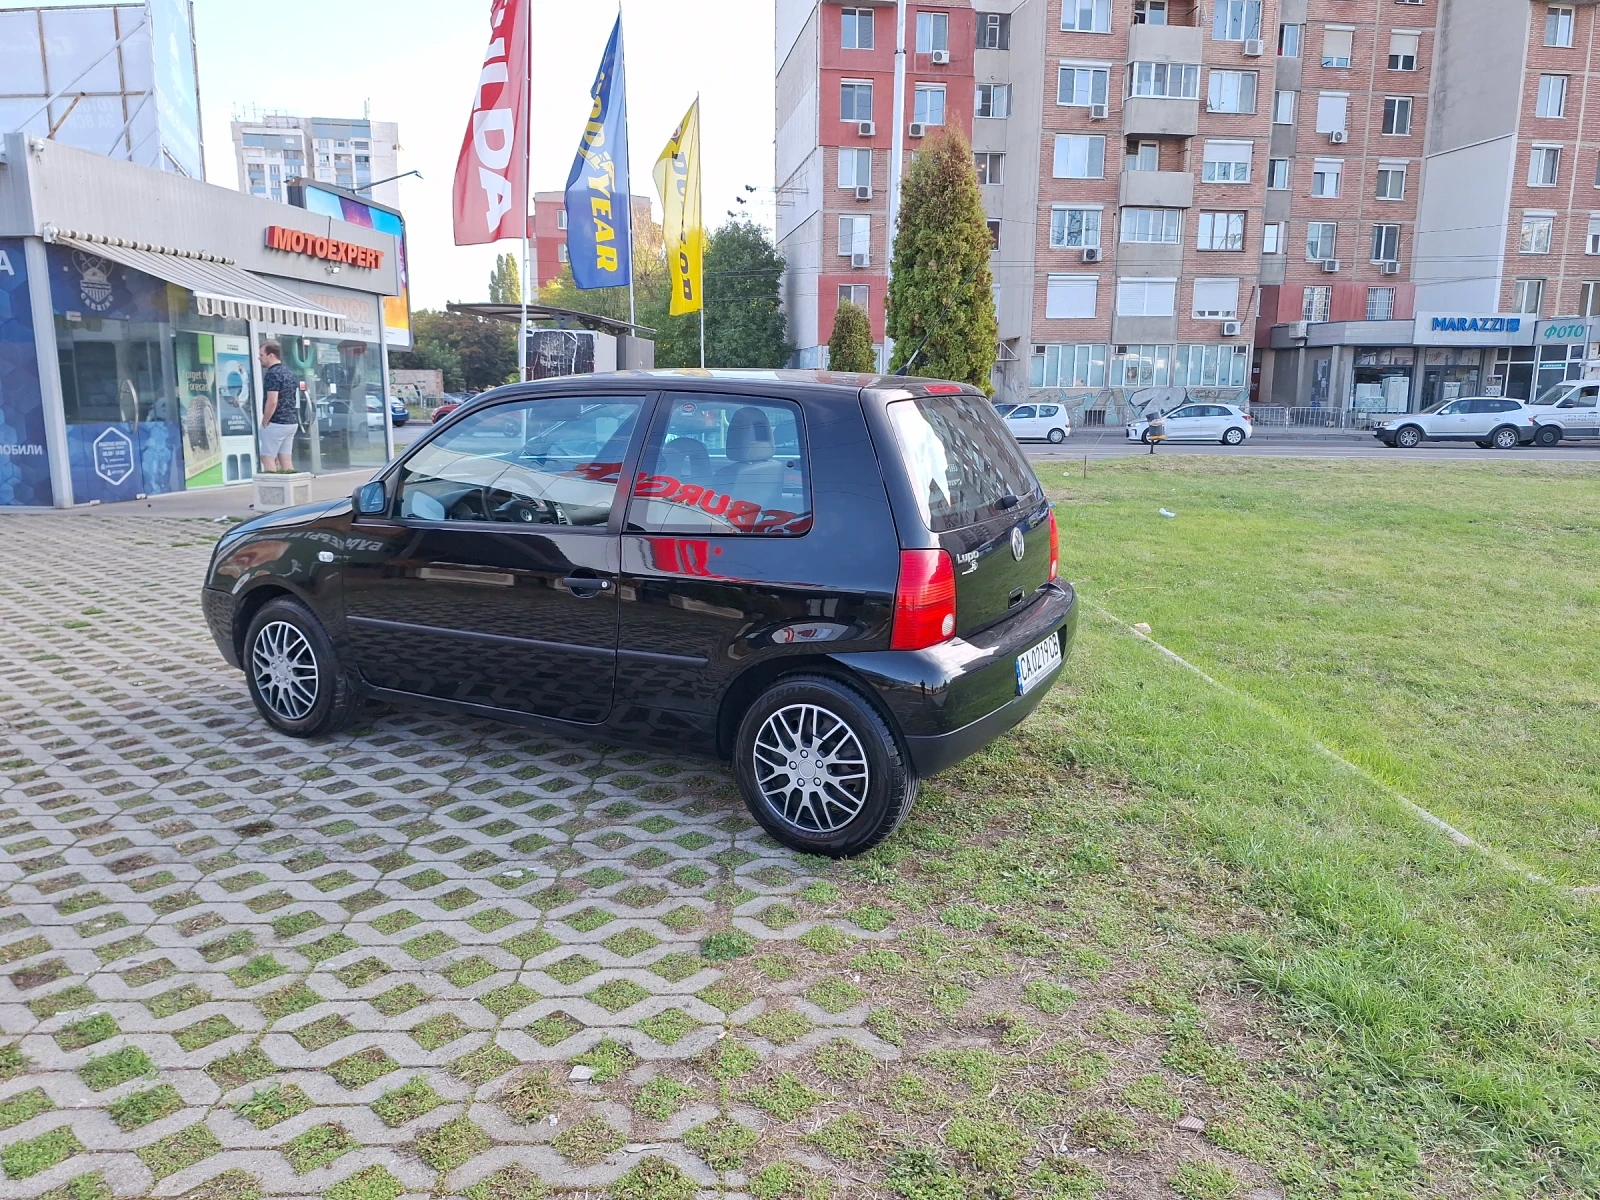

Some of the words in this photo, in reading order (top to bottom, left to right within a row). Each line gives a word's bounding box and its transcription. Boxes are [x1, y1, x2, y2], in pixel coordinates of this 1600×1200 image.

[268, 226, 385, 270] MOTOEXPERT
[1431, 317, 1505, 331] MARAZZI
[1543, 324, 1585, 340] ФОТО
[186, 381, 210, 392] Forecas
[956, 550, 980, 567] Lupo
